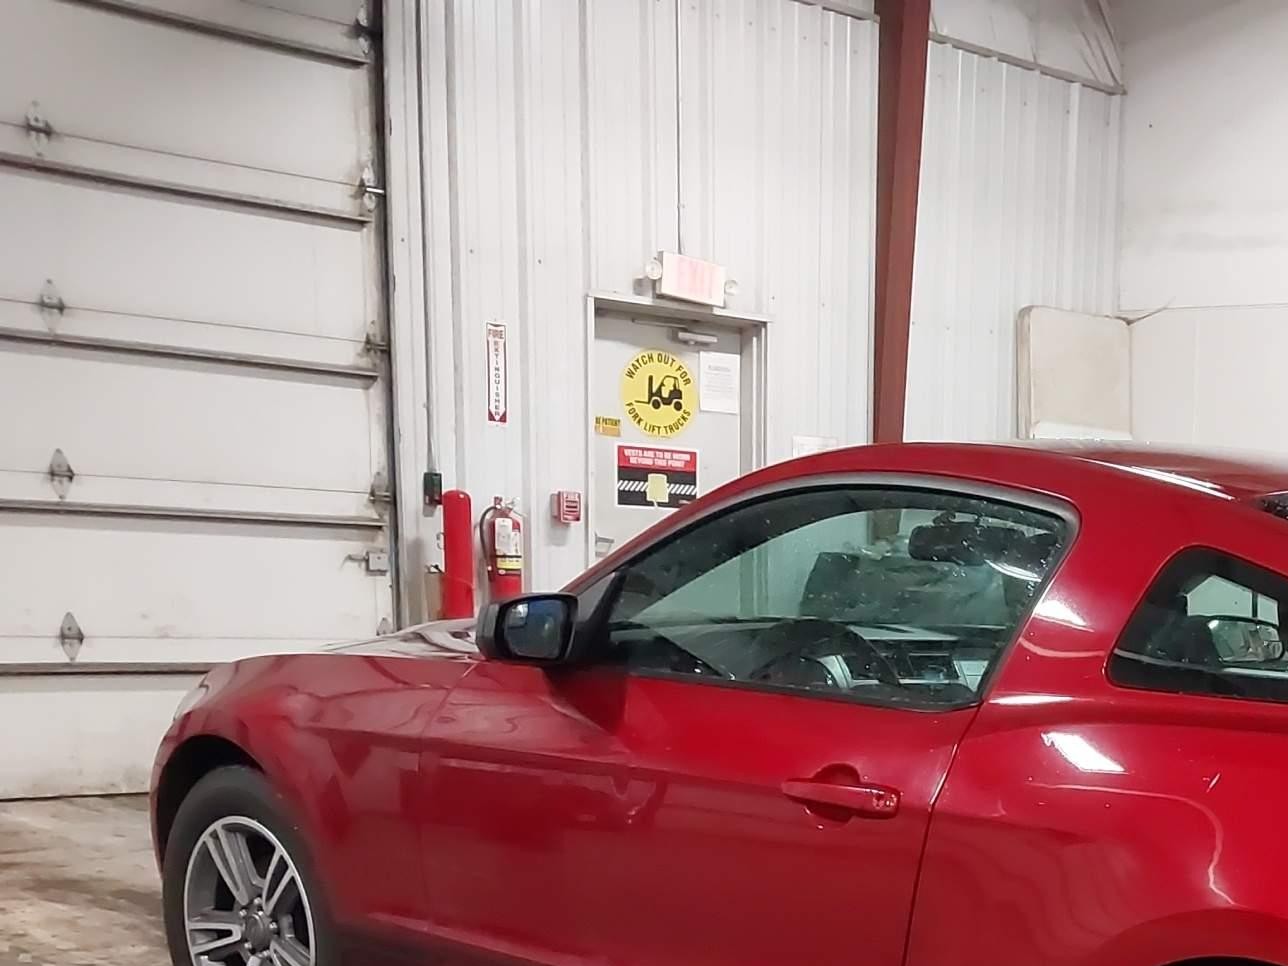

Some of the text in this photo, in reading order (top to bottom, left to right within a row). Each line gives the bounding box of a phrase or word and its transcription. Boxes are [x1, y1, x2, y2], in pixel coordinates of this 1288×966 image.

[488, 328, 504, 340] FIRE
[493, 340, 501, 416] EXTINGUISHER
[625, 352, 654, 379] WATCH
[657, 352, 676, 367] OUT
[675, 365, 691, 386] FOR
[625, 402, 691, 434] FORK LIFT TRUCKS
